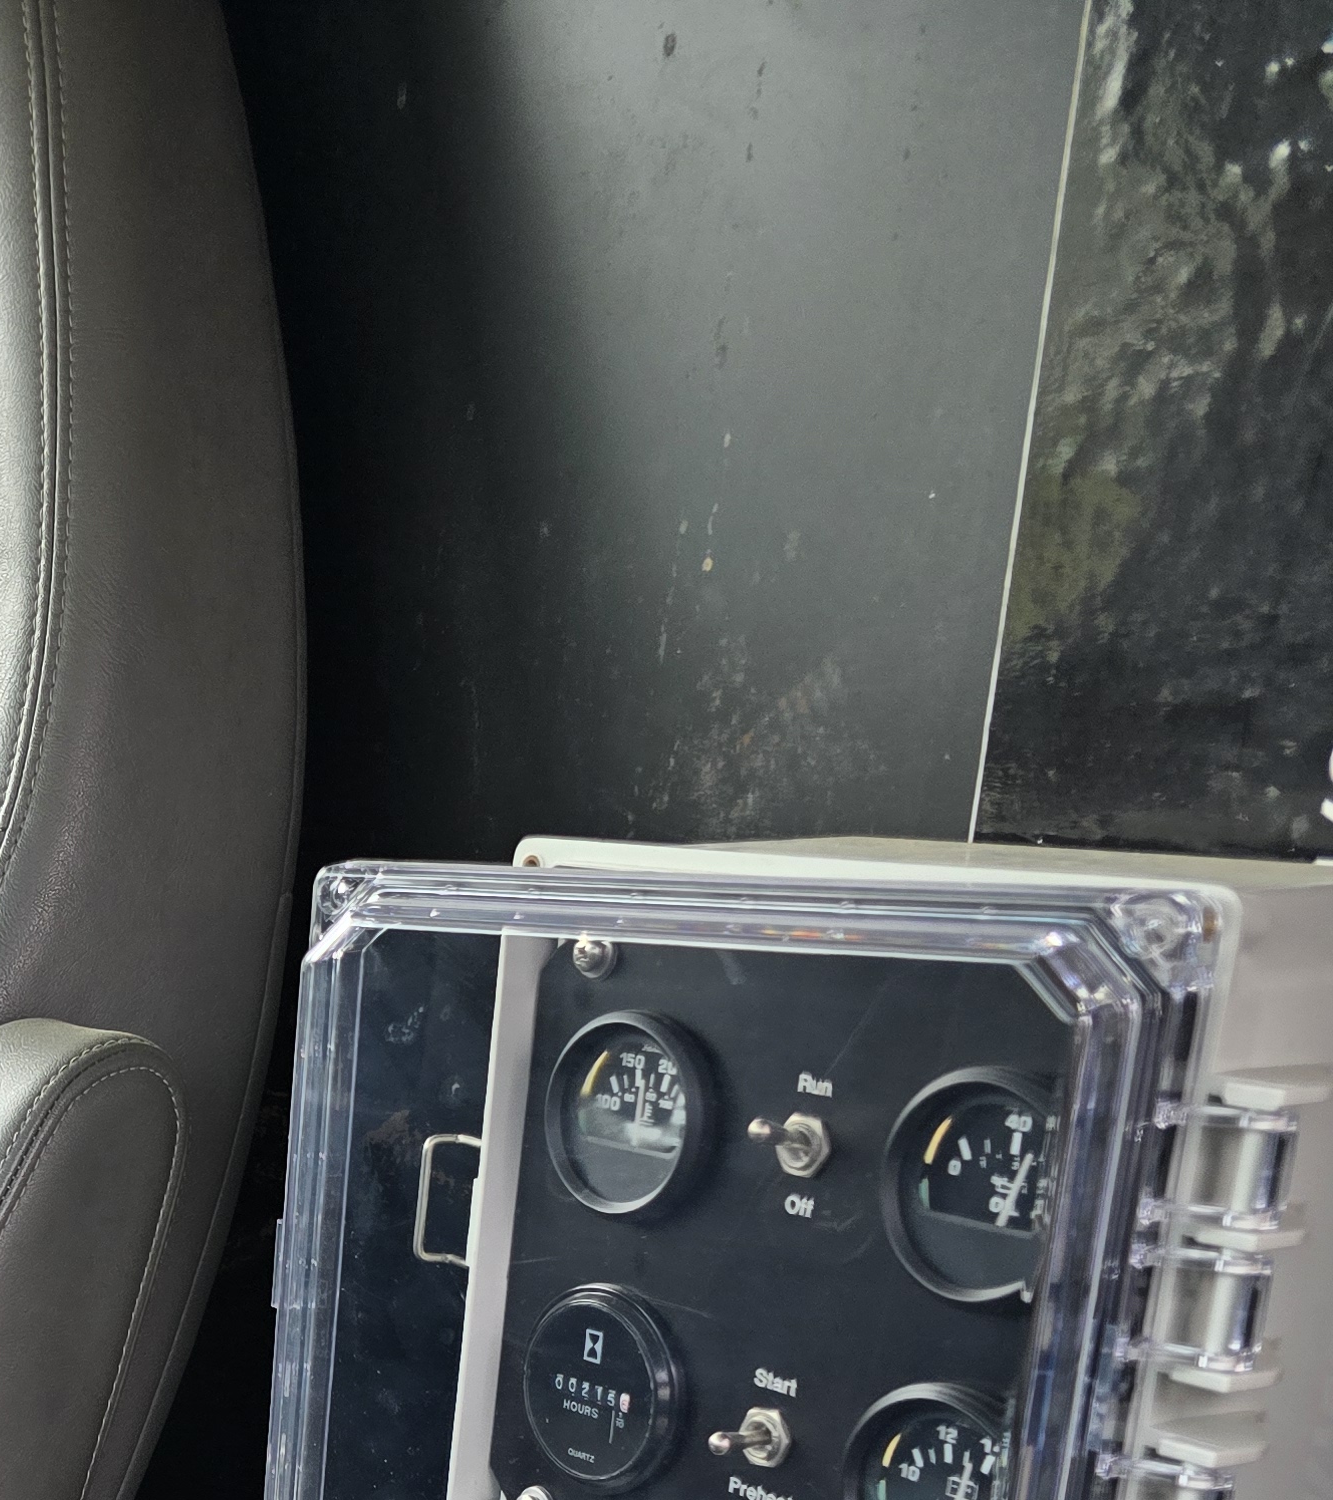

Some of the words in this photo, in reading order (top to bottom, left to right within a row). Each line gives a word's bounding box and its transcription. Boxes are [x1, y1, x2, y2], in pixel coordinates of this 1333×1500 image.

[620, 1052, 645, 1069] 150
[797, 1071, 833, 1098] Run
[595, 1094, 621, 1111] 100
[1004, 1113, 1033, 1133] 40
[948, 1158, 962, 1177] 0
[784, 1193, 815, 1219] Off
[753, 1367, 798, 1398] Start
[562, 1398, 599, 1419] HOURS
[936, 1425, 959, 1444] 12
[567, 1447, 595, 1464] QUARTZ
[898, 1462, 921, 1482] 10
